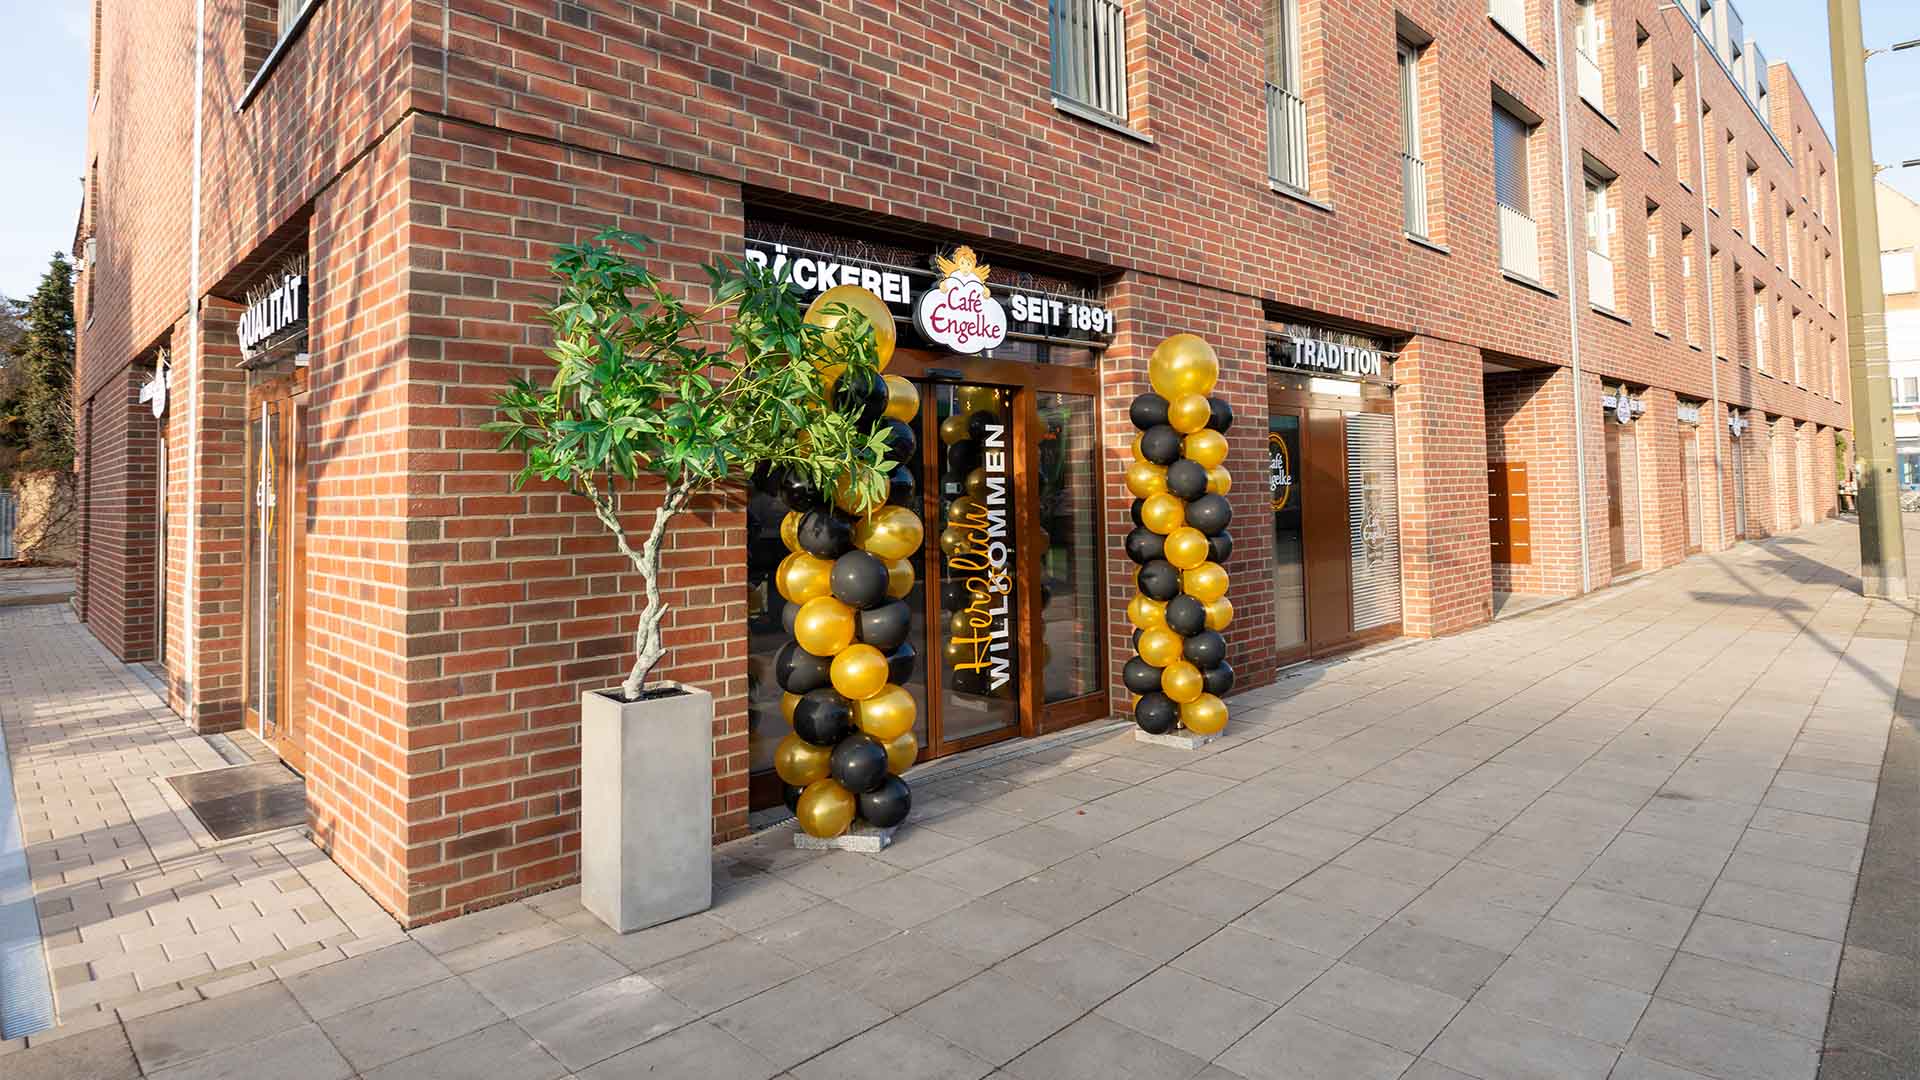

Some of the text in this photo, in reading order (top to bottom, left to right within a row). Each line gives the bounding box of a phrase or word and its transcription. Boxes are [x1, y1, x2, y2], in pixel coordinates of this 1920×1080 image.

[240, 275, 301, 347] QUALITÄT
[947, 286, 983, 313] Café
[1011, 294, 1112, 333] SEIT 1891
[930, 303, 1000, 344] Engelke
[1293, 338, 1381, 376] TRADITION
[1269, 453, 1283, 469] afé
[985, 424, 1010, 690] WILLKOMMEN
[948, 503, 1012, 674] Herzlich
